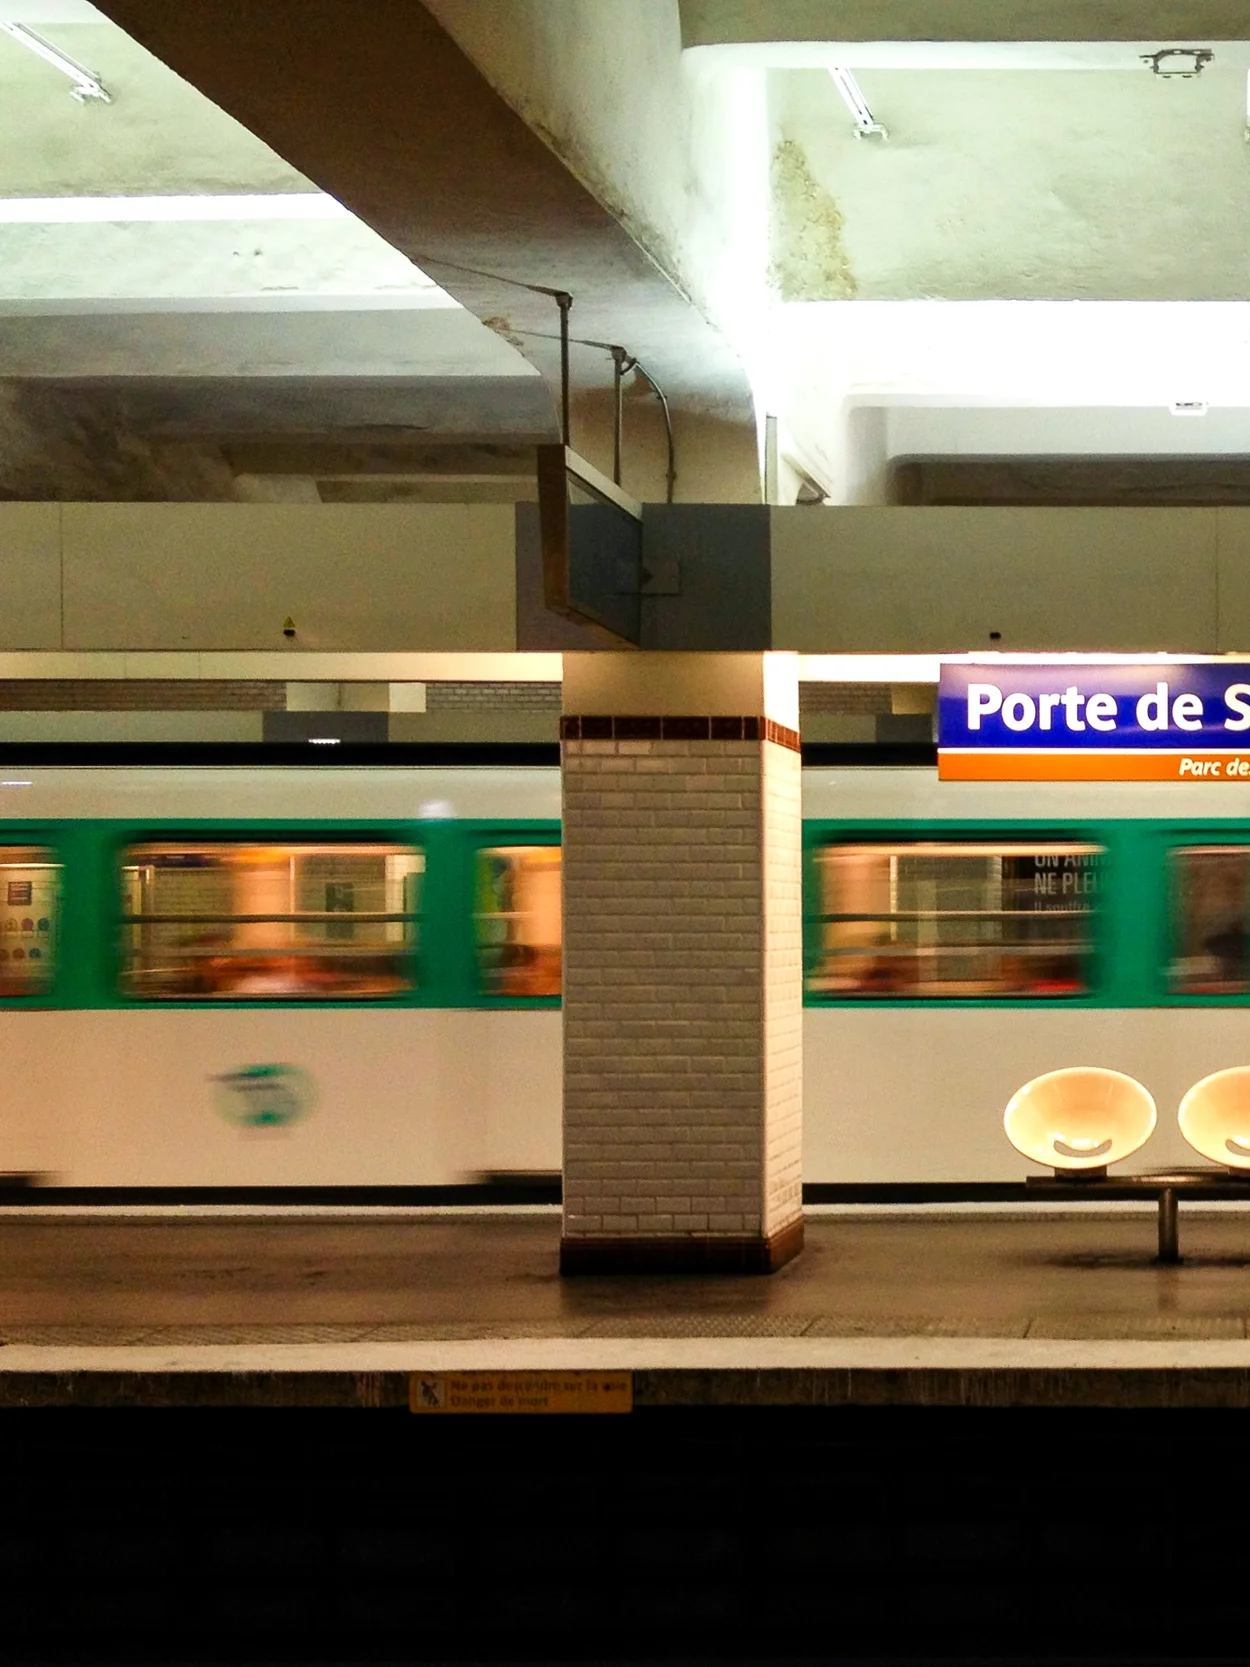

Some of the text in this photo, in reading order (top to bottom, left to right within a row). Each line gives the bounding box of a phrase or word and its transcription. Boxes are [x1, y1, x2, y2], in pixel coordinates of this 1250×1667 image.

[966, 683, 1118, 731] Porte
[1135, 682, 1203, 731] de
[1178, 757, 1222, 776] Parc
[1034, 872, 1057, 895] NE
[472, 1381, 494, 1393] pas
